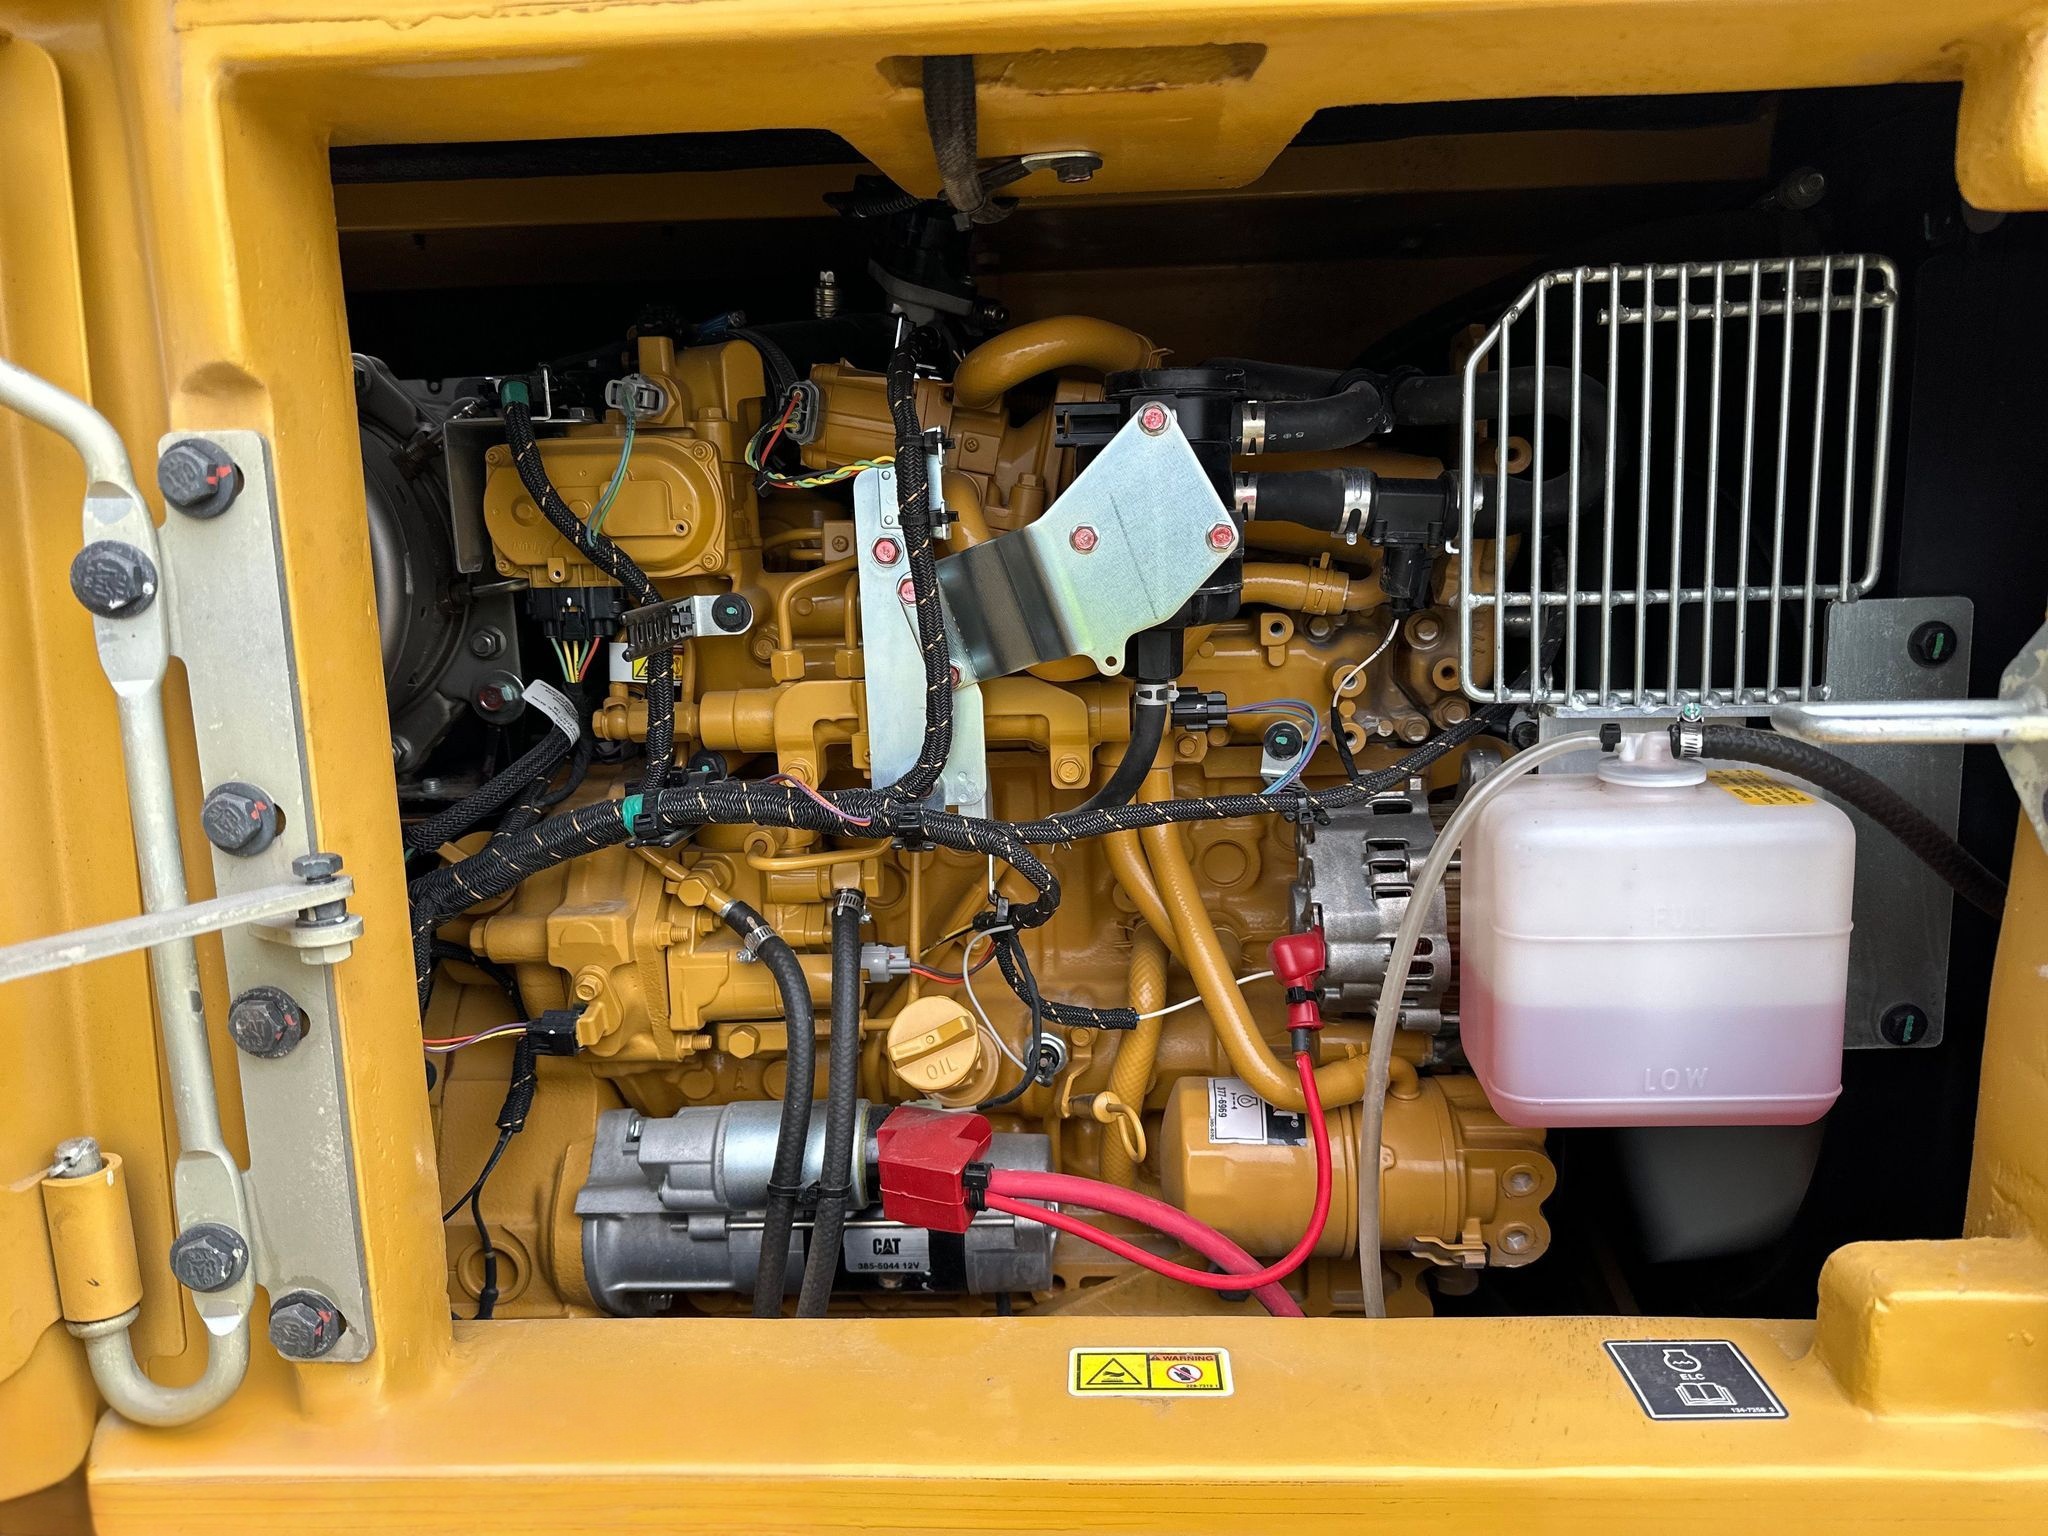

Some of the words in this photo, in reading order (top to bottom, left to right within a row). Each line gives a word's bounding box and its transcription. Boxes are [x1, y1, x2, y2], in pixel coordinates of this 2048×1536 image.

[1654, 904, 1713, 928] FULL
[926, 1057, 958, 1080] OIL
[1644, 1067, 1709, 1092] LOW
[1216, 1086, 1228, 1118] 377-6969
[872, 1238, 901, 1255] CAT
[902, 1261, 920, 1270] 12V
[1680, 1373, 1706, 1381] ELC
